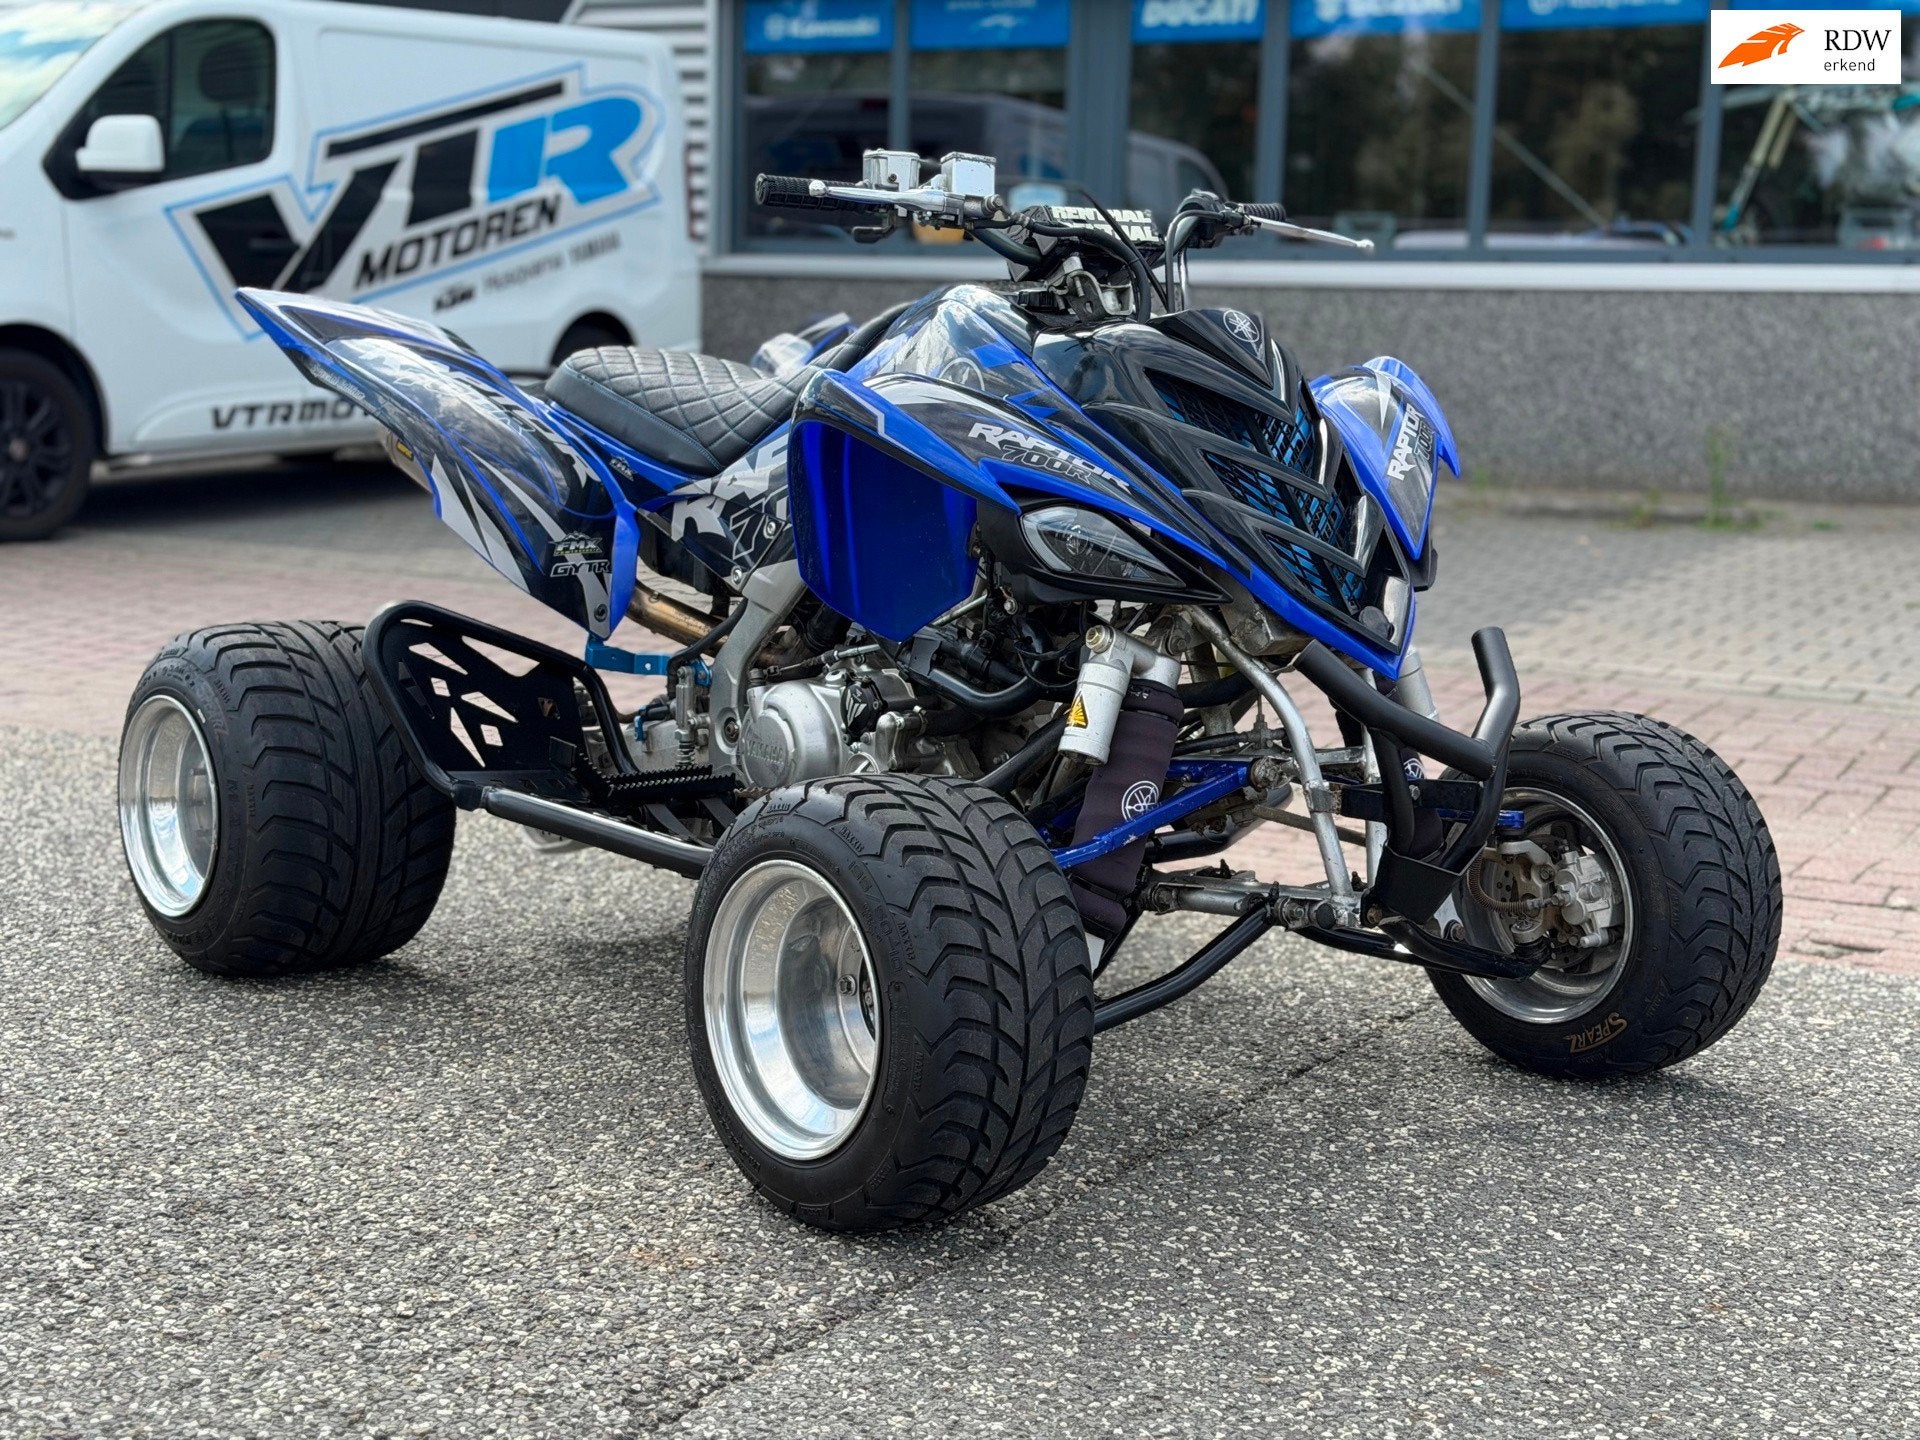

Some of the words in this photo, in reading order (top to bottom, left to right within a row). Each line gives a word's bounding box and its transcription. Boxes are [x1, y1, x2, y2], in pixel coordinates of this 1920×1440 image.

[194, 81, 642, 292] VTR
[1051, 206, 1152, 223] RENTHAL
[354, 195, 562, 290] MOTOREN
[212, 401, 370, 429] VTRMO
[968, 422, 1132, 496] RAPTOR
[1386, 403, 1426, 481] RAPTOR
[1001, 445, 1091, 485] 700R
[555, 540, 600, 551] FMX
[550, 559, 611, 578] GYTR
